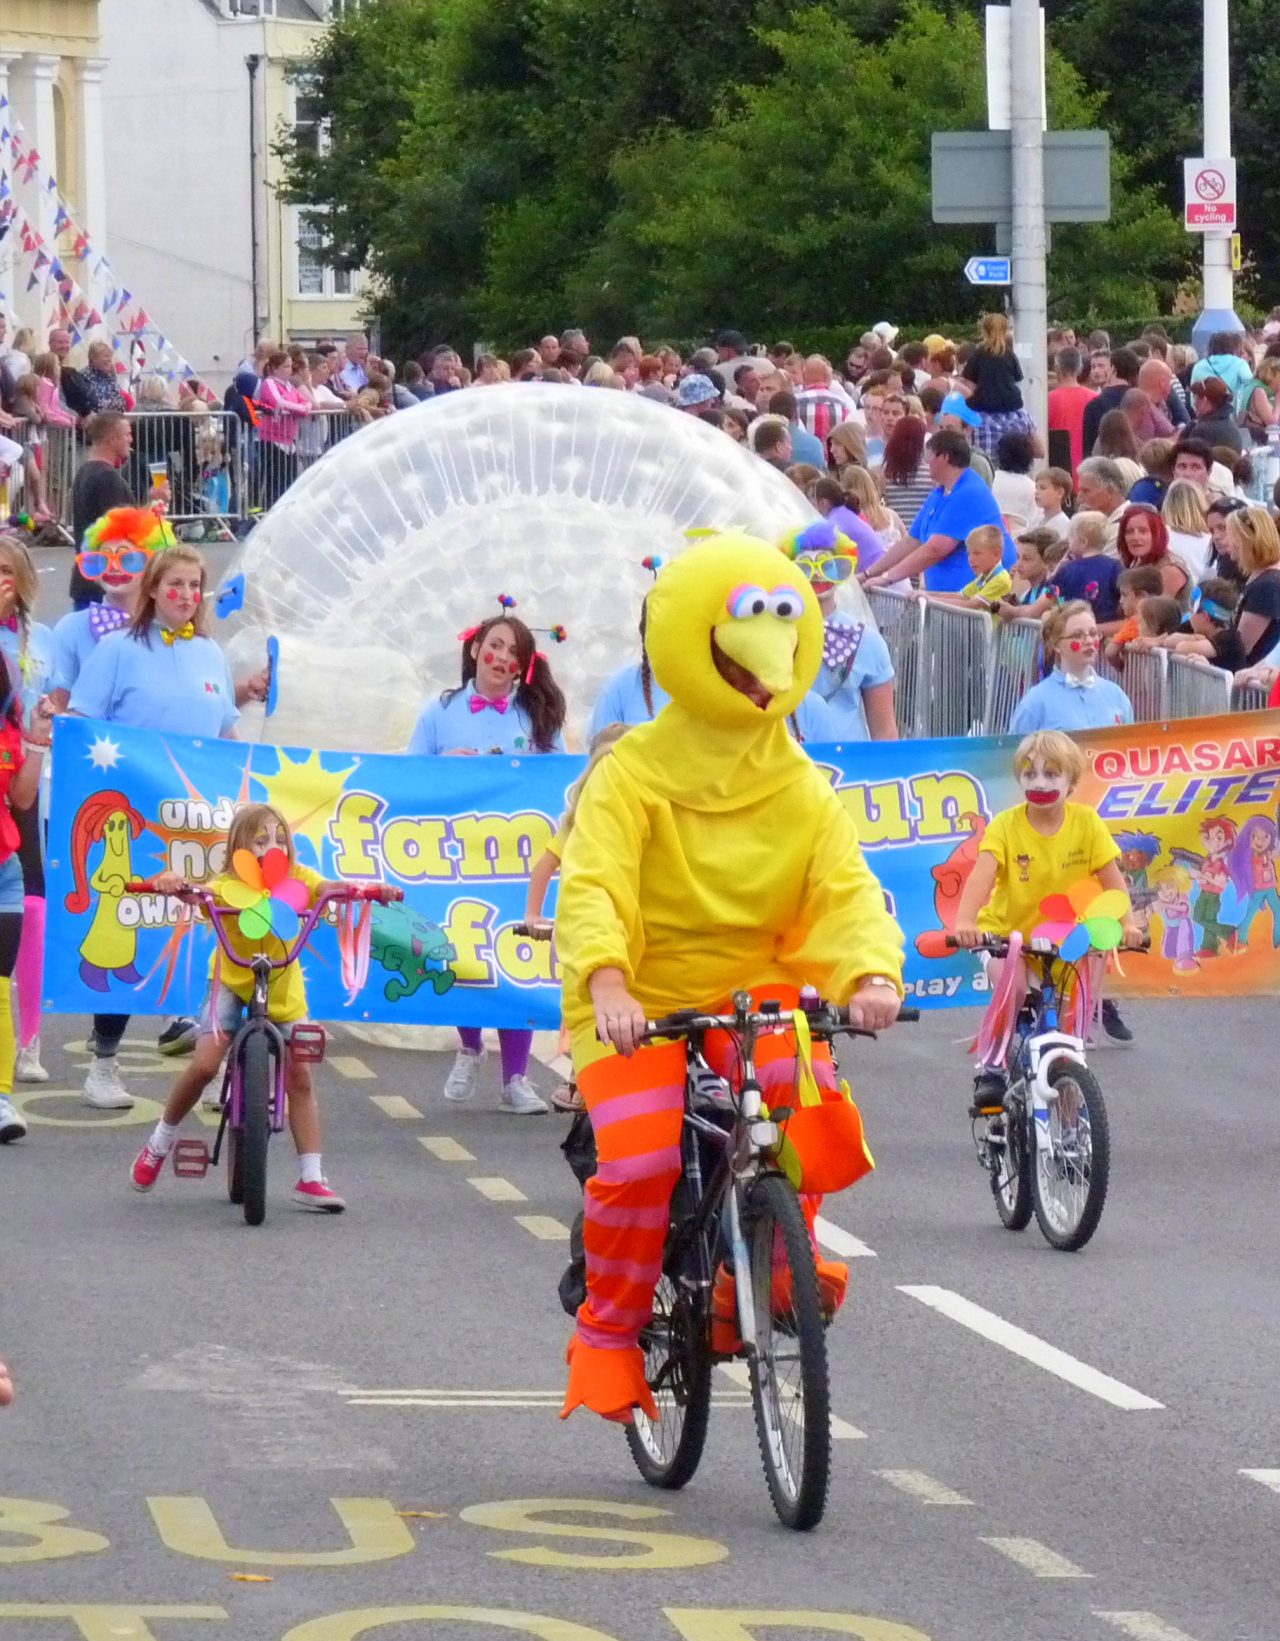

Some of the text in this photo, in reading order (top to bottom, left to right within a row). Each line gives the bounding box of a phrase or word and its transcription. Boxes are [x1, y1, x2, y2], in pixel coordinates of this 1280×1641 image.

[1194, 213, 1227, 224] cycling
[1204, 203, 1217, 212] No
[815, 762, 992, 850] un
[329, 790, 563, 884] fam
